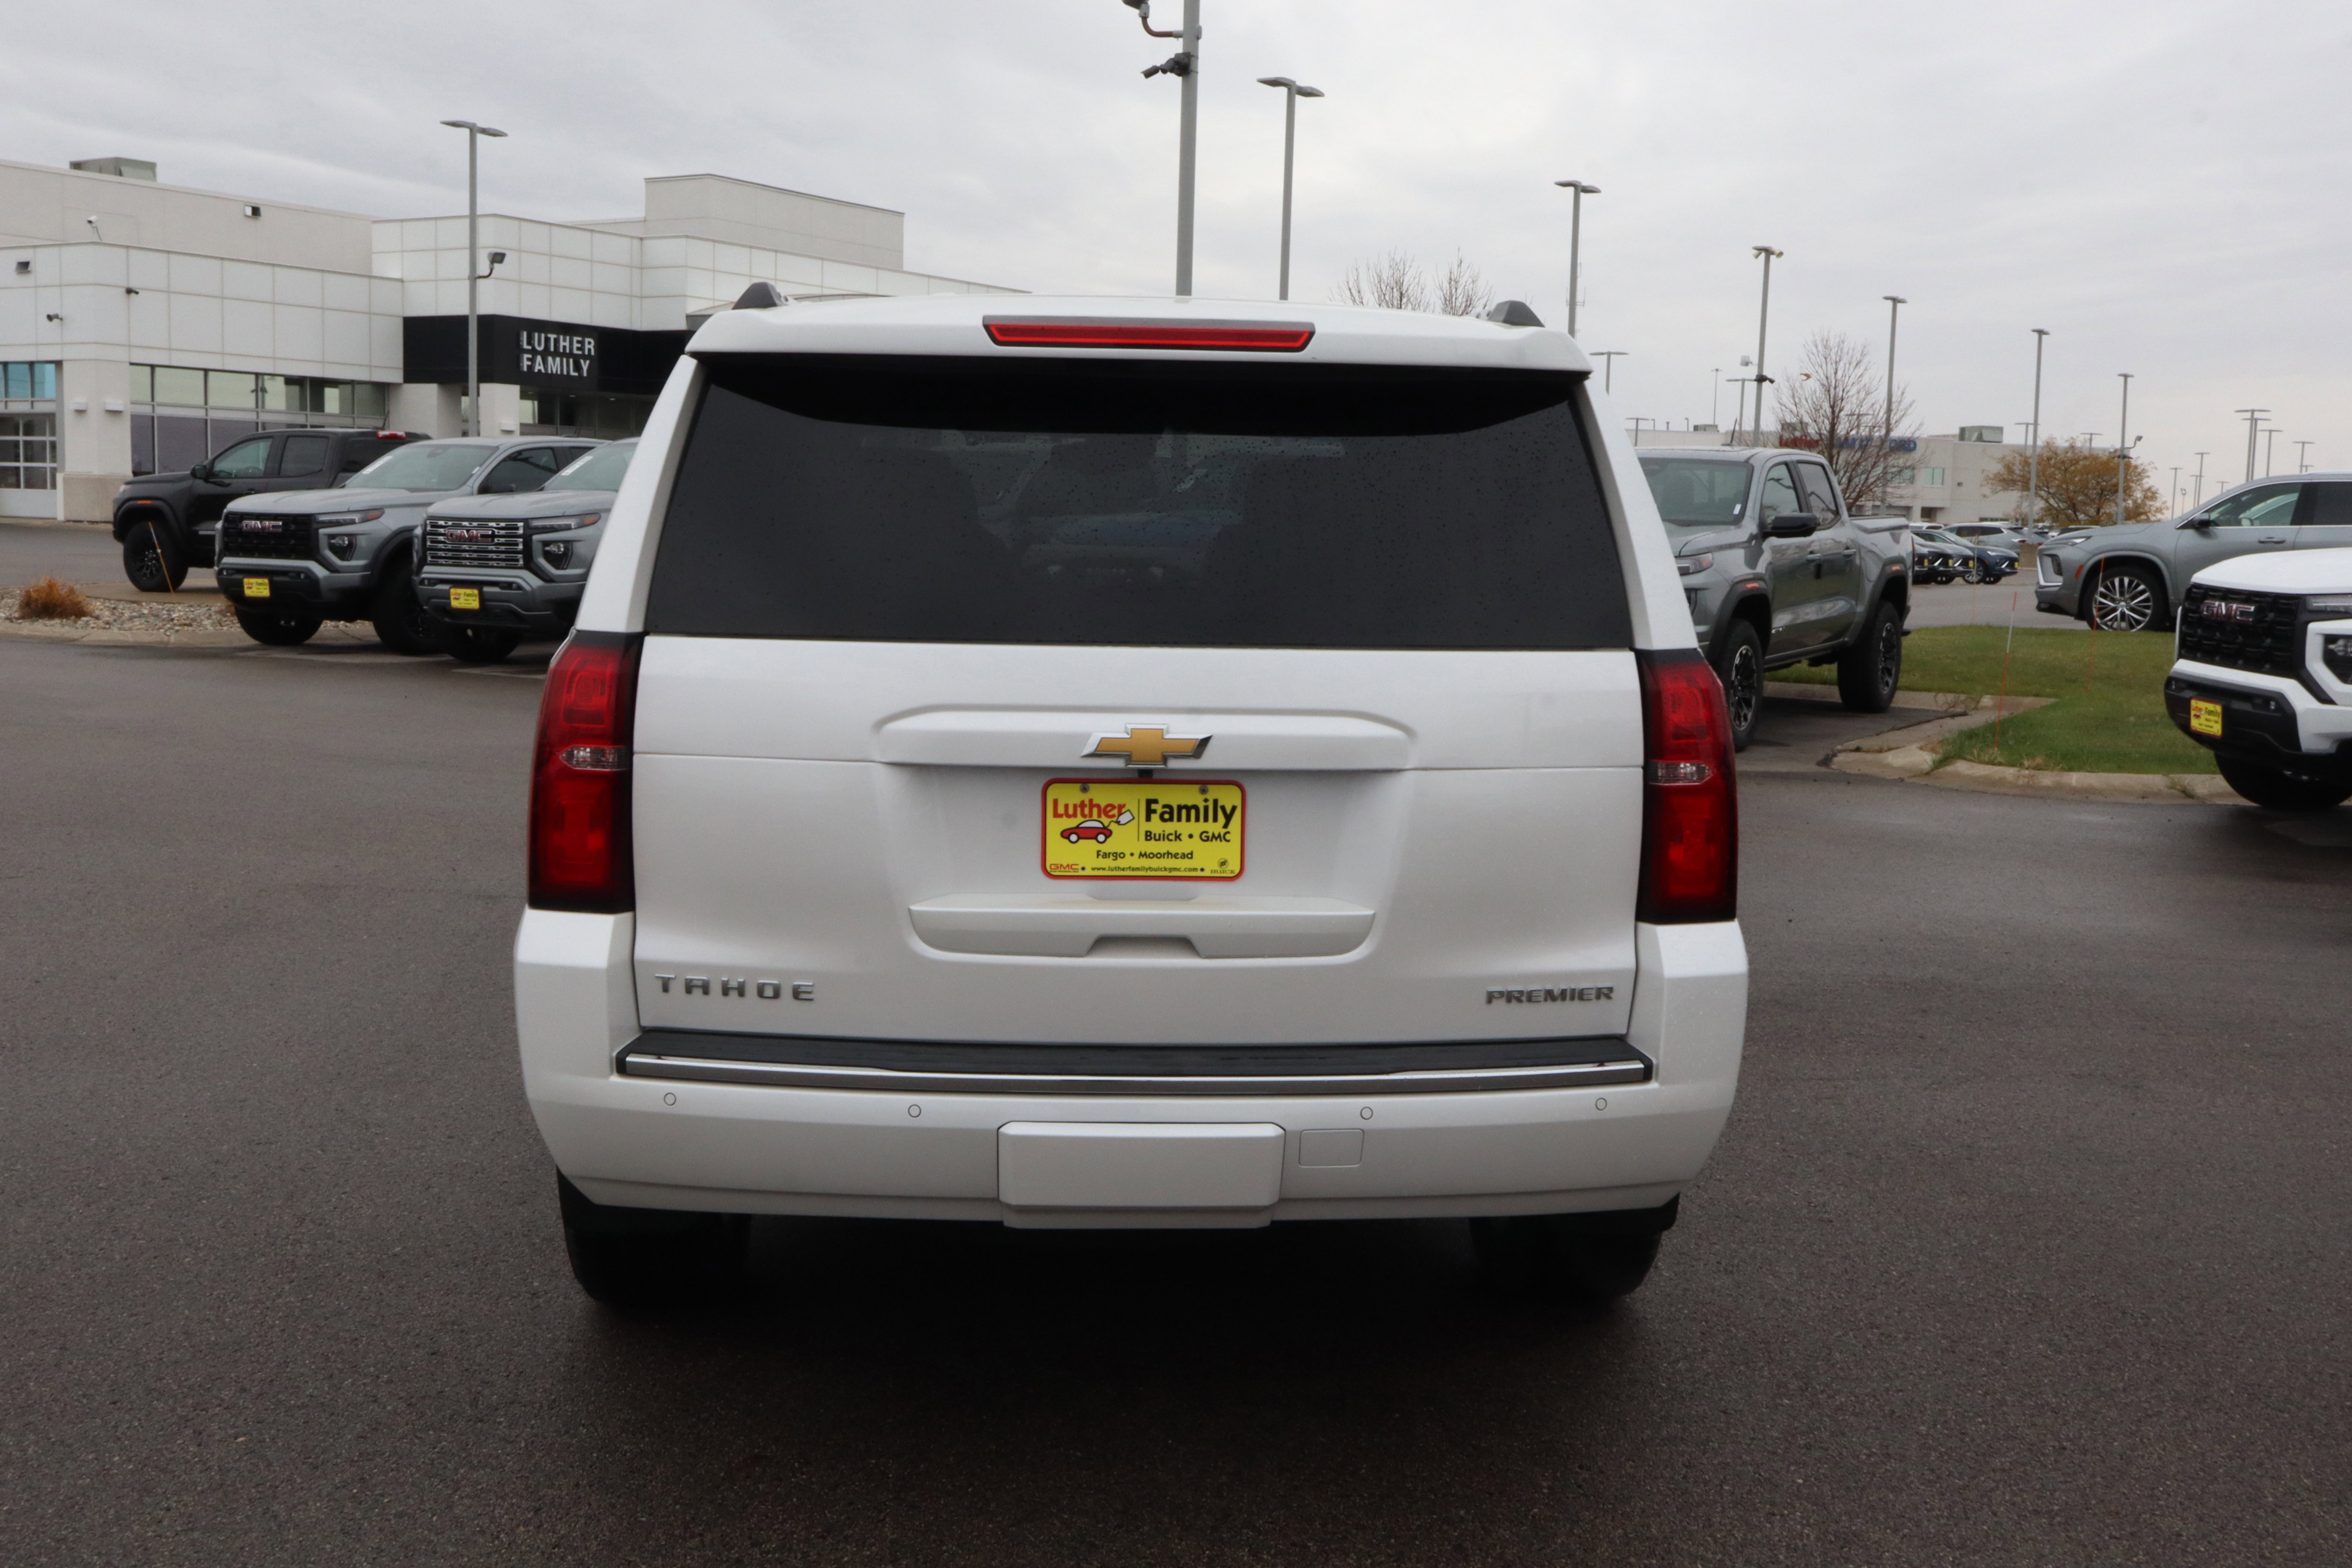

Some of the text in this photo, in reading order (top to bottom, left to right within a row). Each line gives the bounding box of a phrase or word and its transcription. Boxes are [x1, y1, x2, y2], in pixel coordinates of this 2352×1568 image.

[521, 331, 595, 356] LUTHER
[521, 353, 590, 377] FAMILY
[241, 520, 283, 532] GMC
[446, 529, 492, 542] GMC
[2201, 600, 2255, 624] GMC
[1053, 797, 1238, 829] Luther Family
[1145, 831, 1231, 842] Buick GMC
[1096, 850, 1194, 860] Fargo Moorhead
[655, 973, 814, 1001] TAHOE
[1486, 985, 1614, 1004] PREMIER
